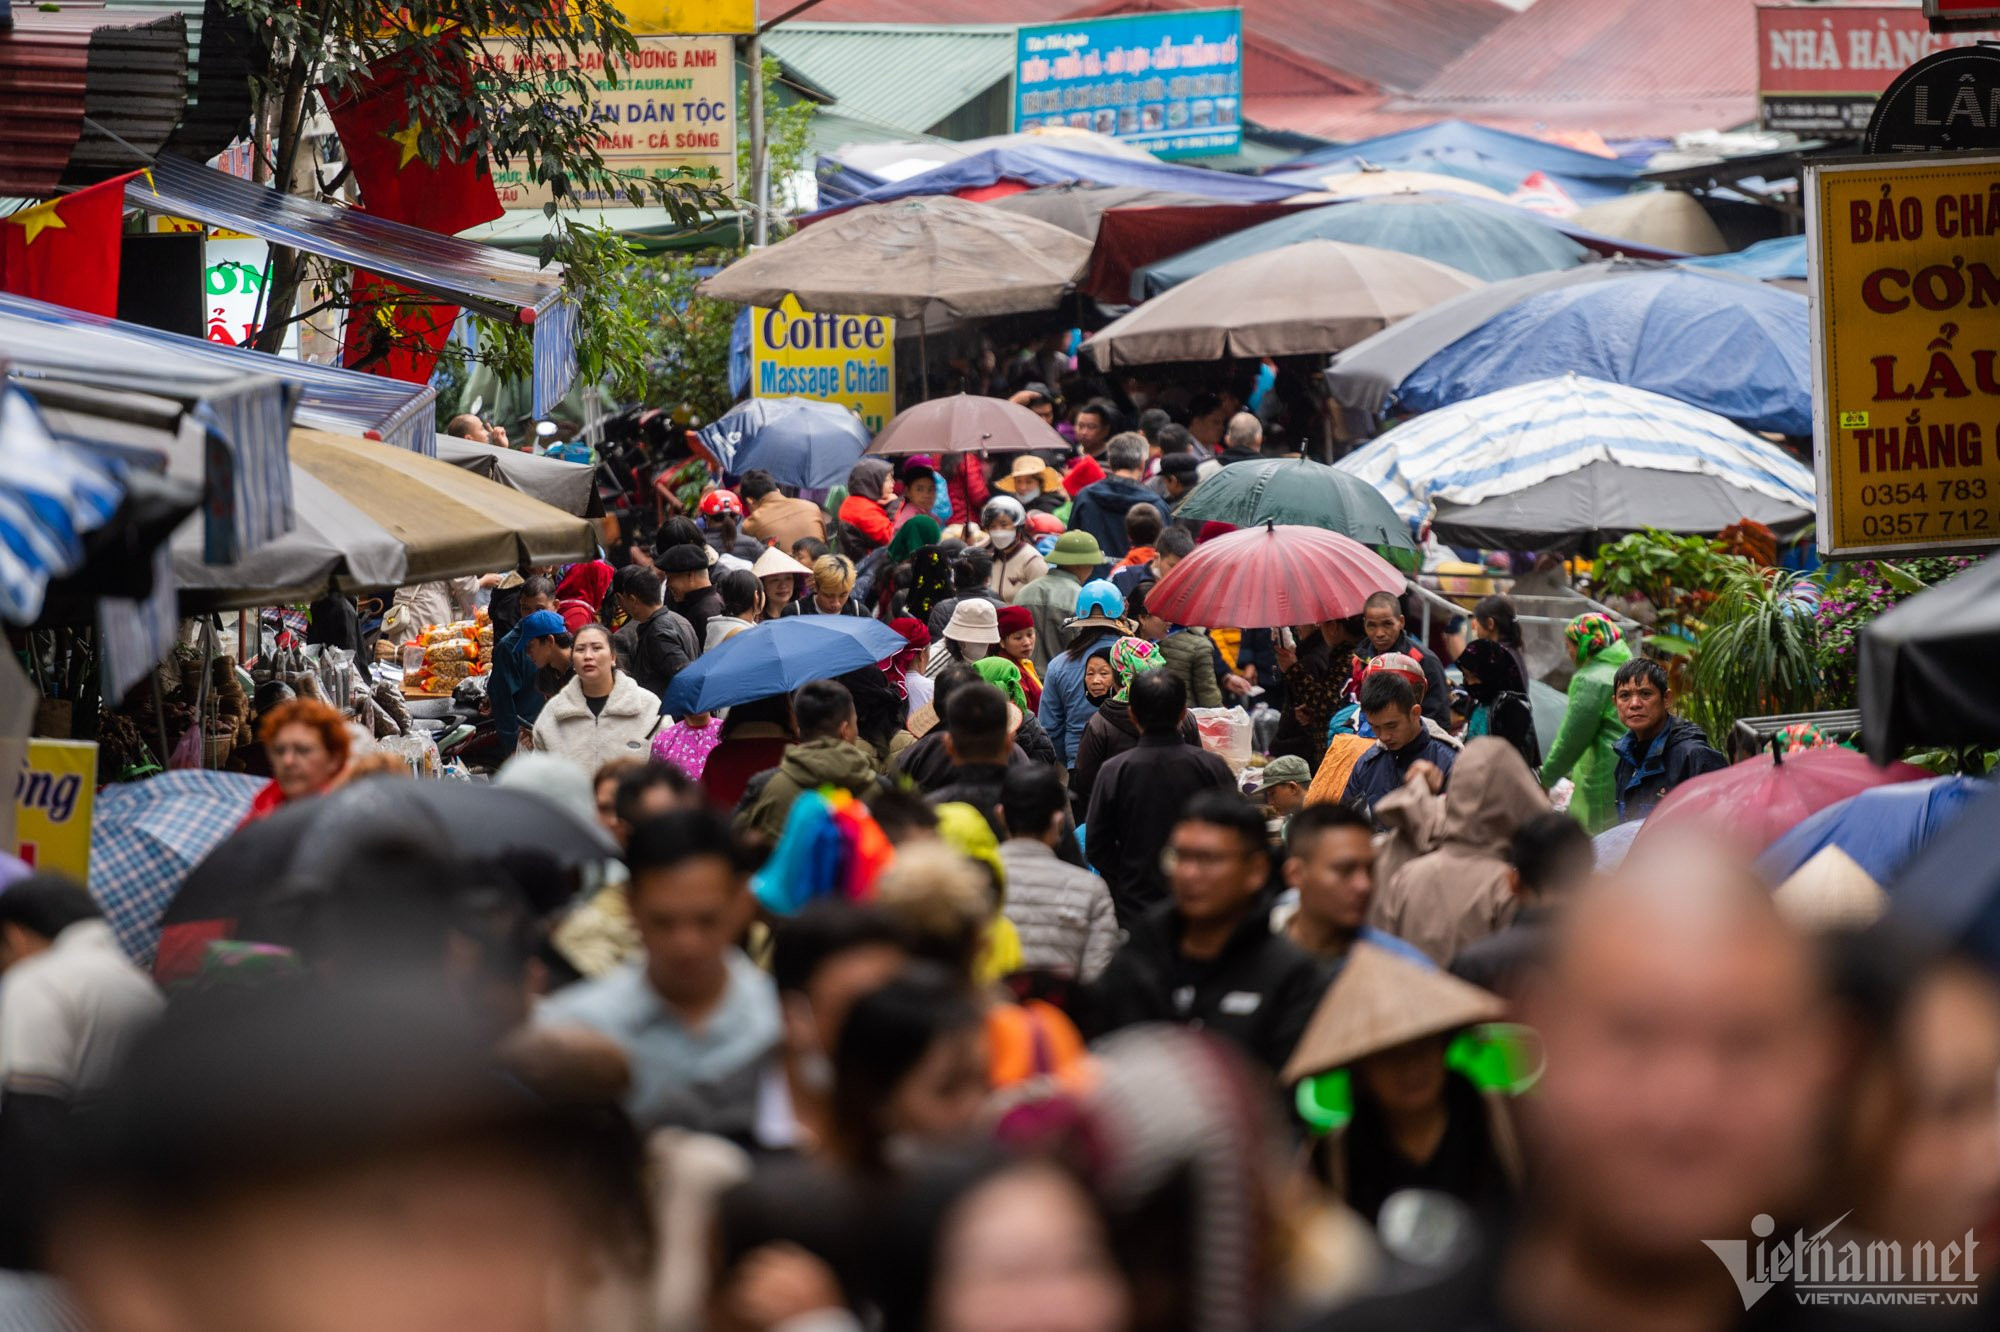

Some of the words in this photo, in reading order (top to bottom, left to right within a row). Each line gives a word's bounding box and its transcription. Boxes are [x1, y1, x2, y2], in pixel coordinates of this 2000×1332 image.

[683, 48, 718, 68] ANH
[1768, 17, 1842, 71] NHÀ
[597, 78, 694, 92] RESTAURANT
[627, 98, 675, 123] DÂN
[683, 97, 726, 126] TỘC
[648, 130, 670, 149] CÁ
[676, 130, 720, 149] SÔNG
[1850, 183, 1923, 244] BẢO
[763, 309, 885, 349] Coffee
[760, 360, 840, 398] Massage
[845, 359, 890, 393] Chân
[1853, 408, 1983, 473] THẮNG
[1861, 482, 1928, 508] 0354
[1937, 478, 1988, 501] 783
[1862, 513, 1929, 537] 0357
[1939, 508, 1990, 531] 712
